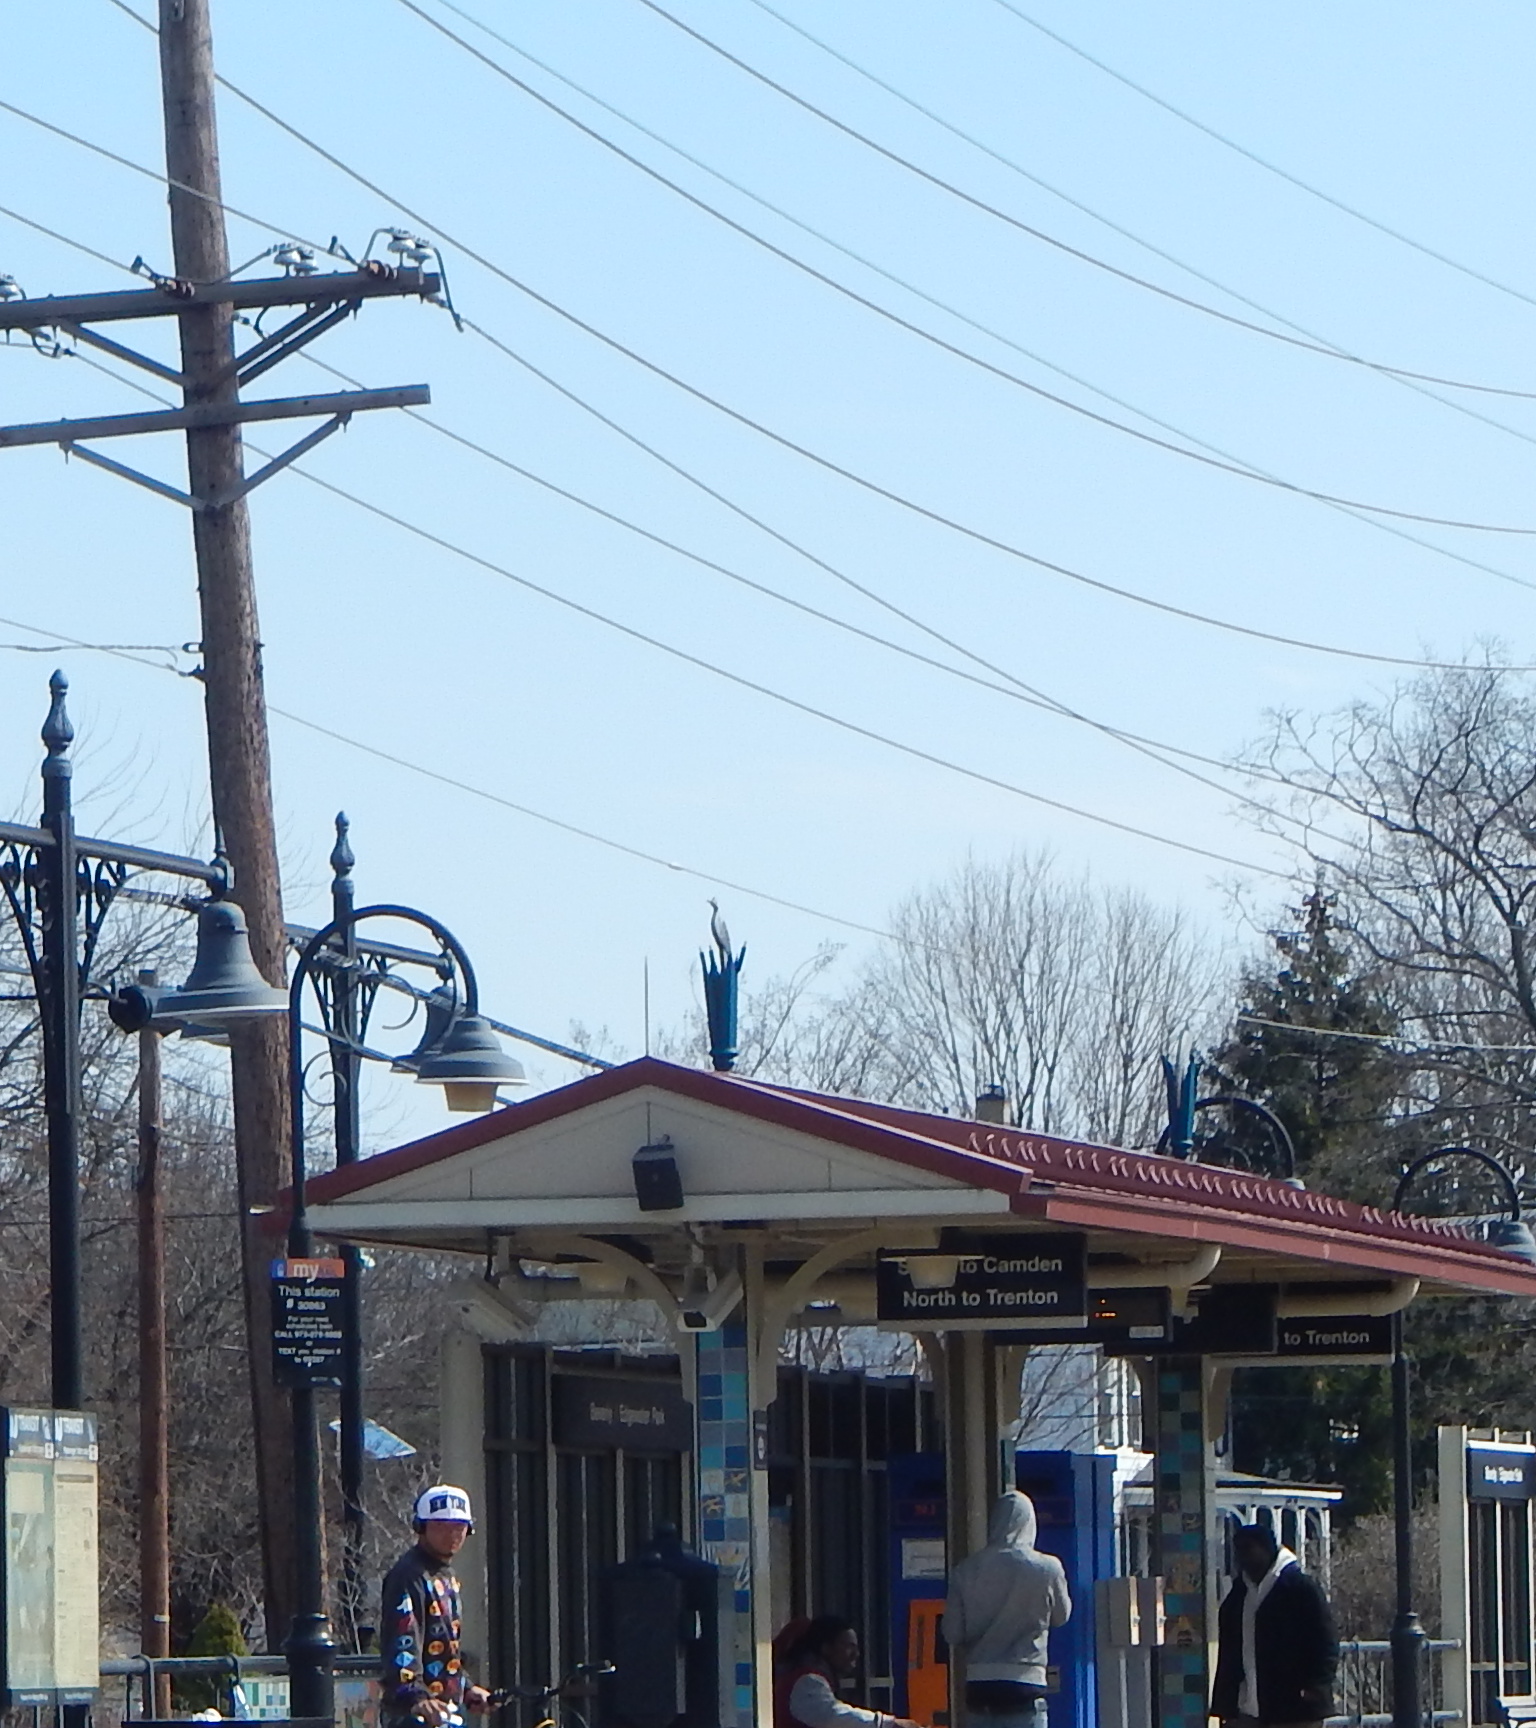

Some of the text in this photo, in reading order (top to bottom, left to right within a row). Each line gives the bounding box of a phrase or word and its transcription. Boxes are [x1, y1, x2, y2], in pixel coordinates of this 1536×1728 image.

[983, 1256, 1063, 1274] Camden
[278, 1285, 340, 1297] This station
[903, 1288, 1058, 1307] North to Trenton
[1284, 1329, 1370, 1345] to Trenton
